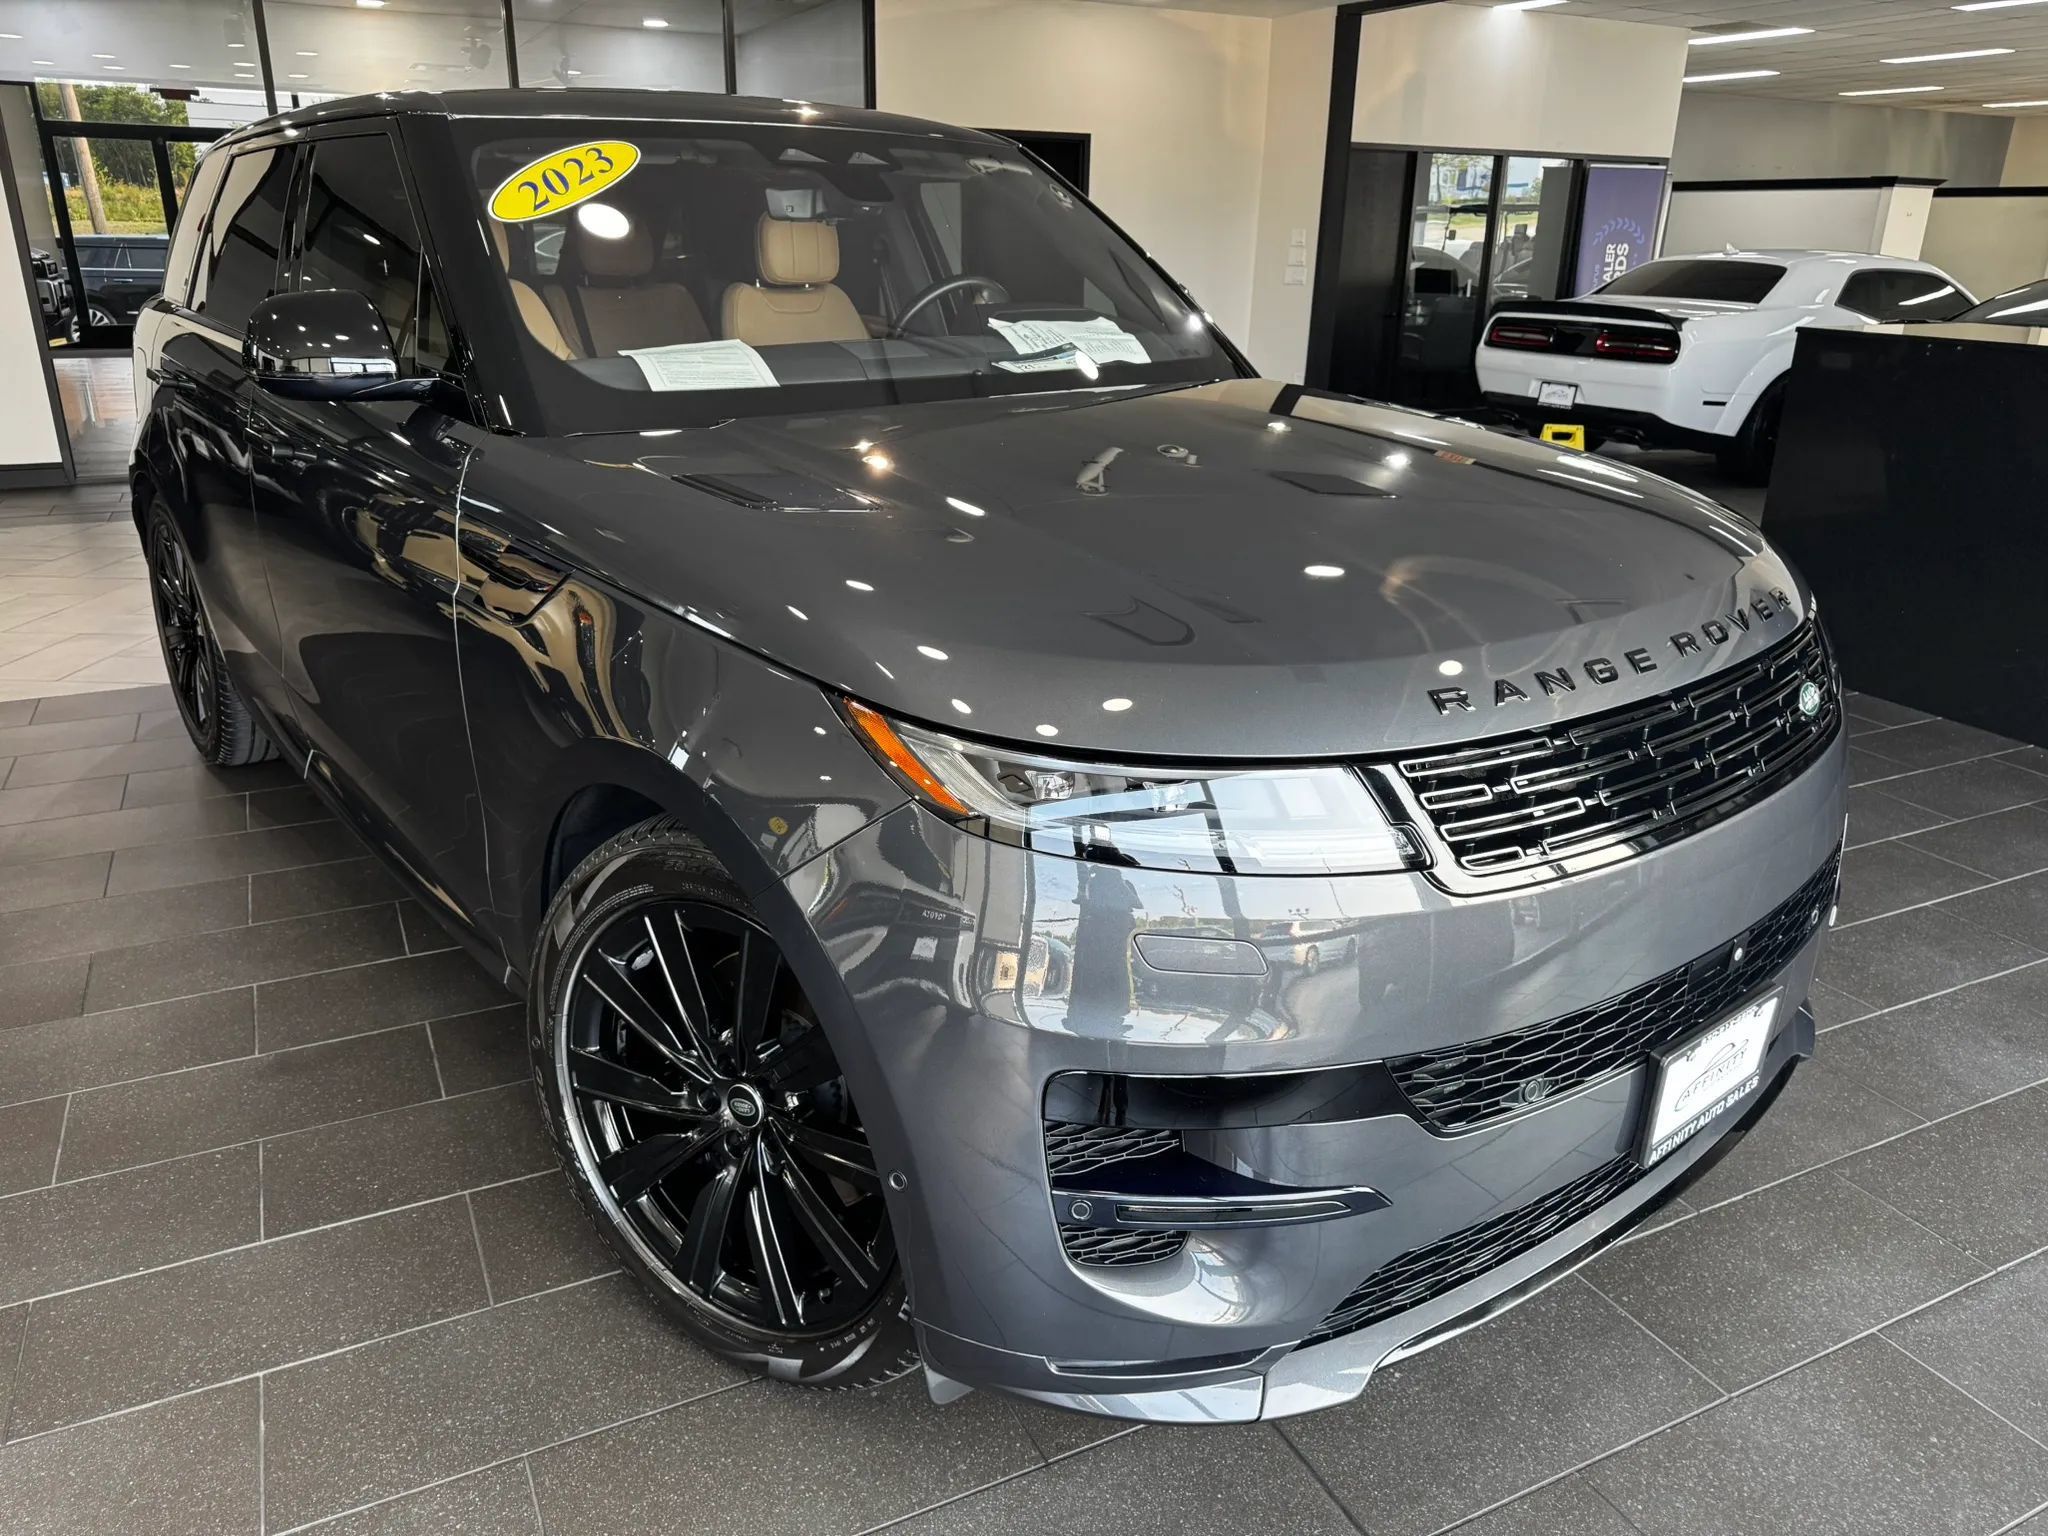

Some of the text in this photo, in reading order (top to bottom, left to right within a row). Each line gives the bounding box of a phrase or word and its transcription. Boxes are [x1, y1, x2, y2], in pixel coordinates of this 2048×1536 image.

[518, 147, 614, 211] 2023
[1427, 586, 1791, 716] RANGE ROVER
[1682, 1047, 1748, 1102] AFFINITY
[1649, 1076, 1760, 1166] AFFINITY AUTO SALES
